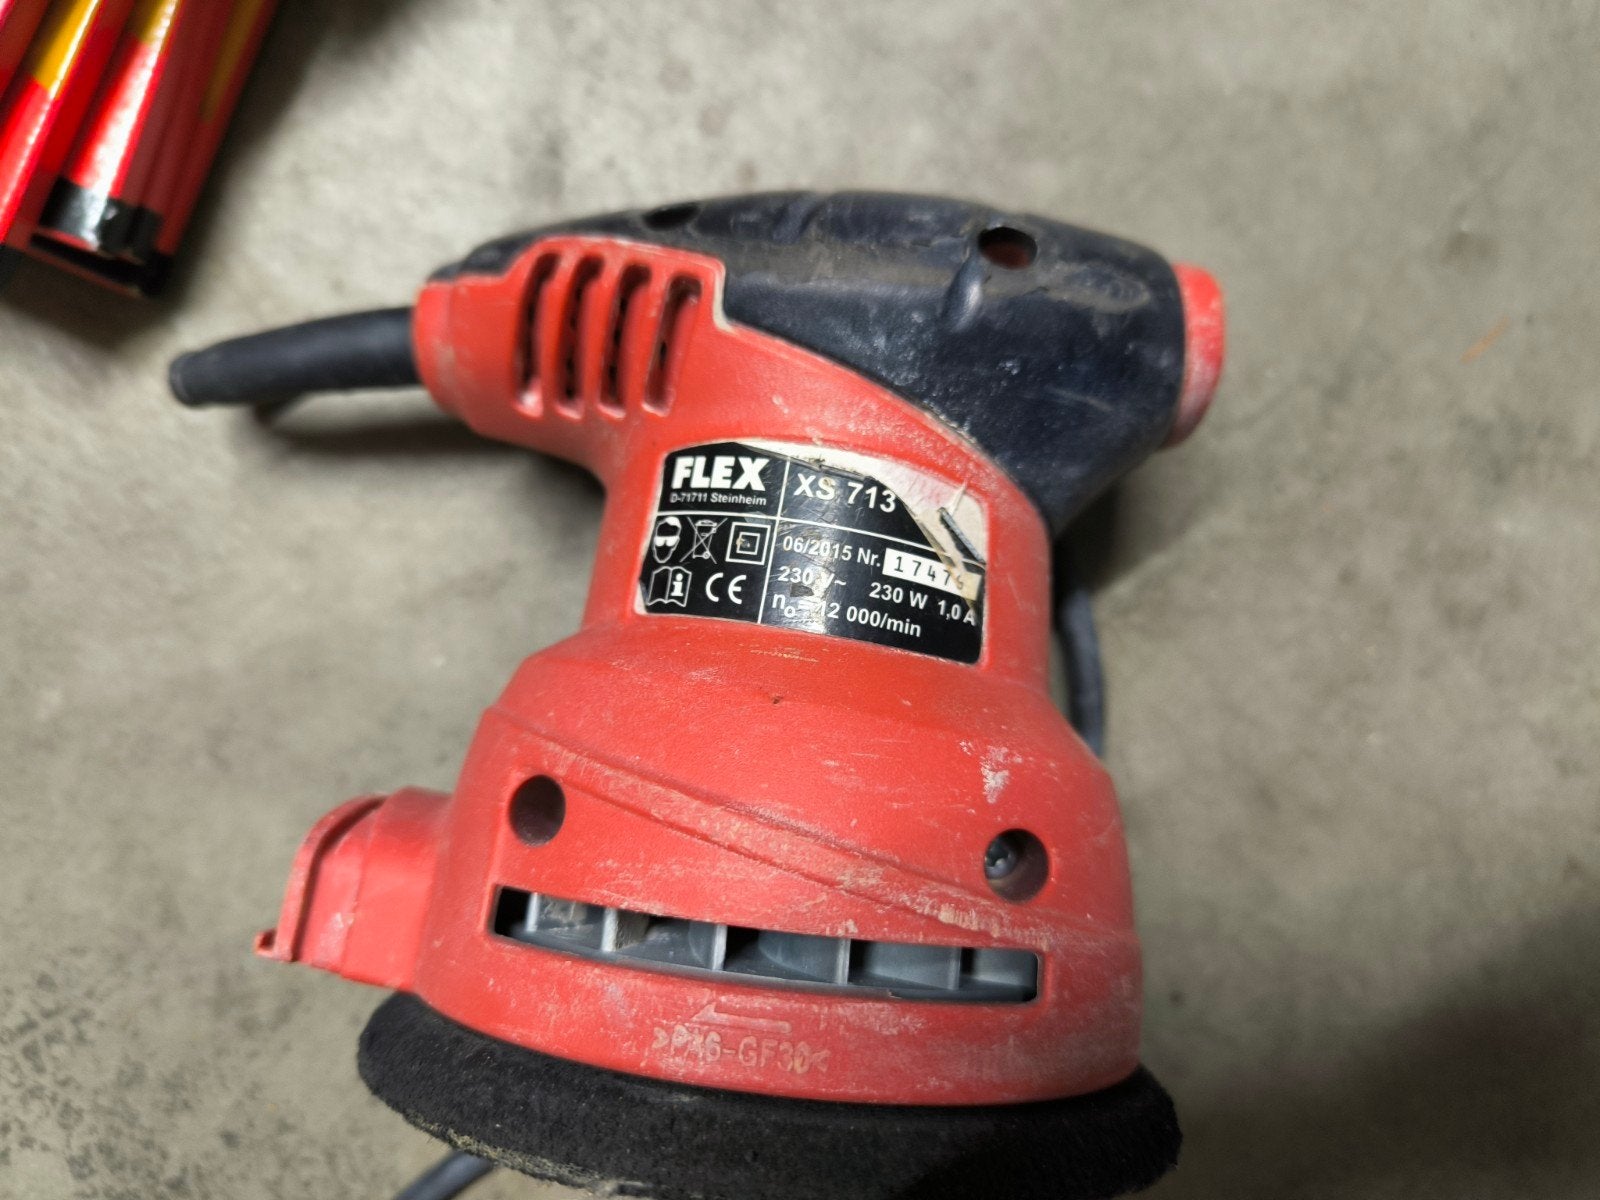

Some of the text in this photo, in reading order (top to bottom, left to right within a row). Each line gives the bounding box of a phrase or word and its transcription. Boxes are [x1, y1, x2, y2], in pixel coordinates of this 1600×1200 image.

[671, 455, 770, 491] FLEX
[669, 491, 767, 506] D-71711 Steinheim
[793, 473, 896, 513] XS 713
[783, 535, 853, 561] 06/2015
[857, 547, 881, 567] Nr.
[778, 565, 814, 587] 230
[869, 582, 904, 604] 230
[909, 590, 928, 610] W
[846, 606, 921, 637] 000/min
